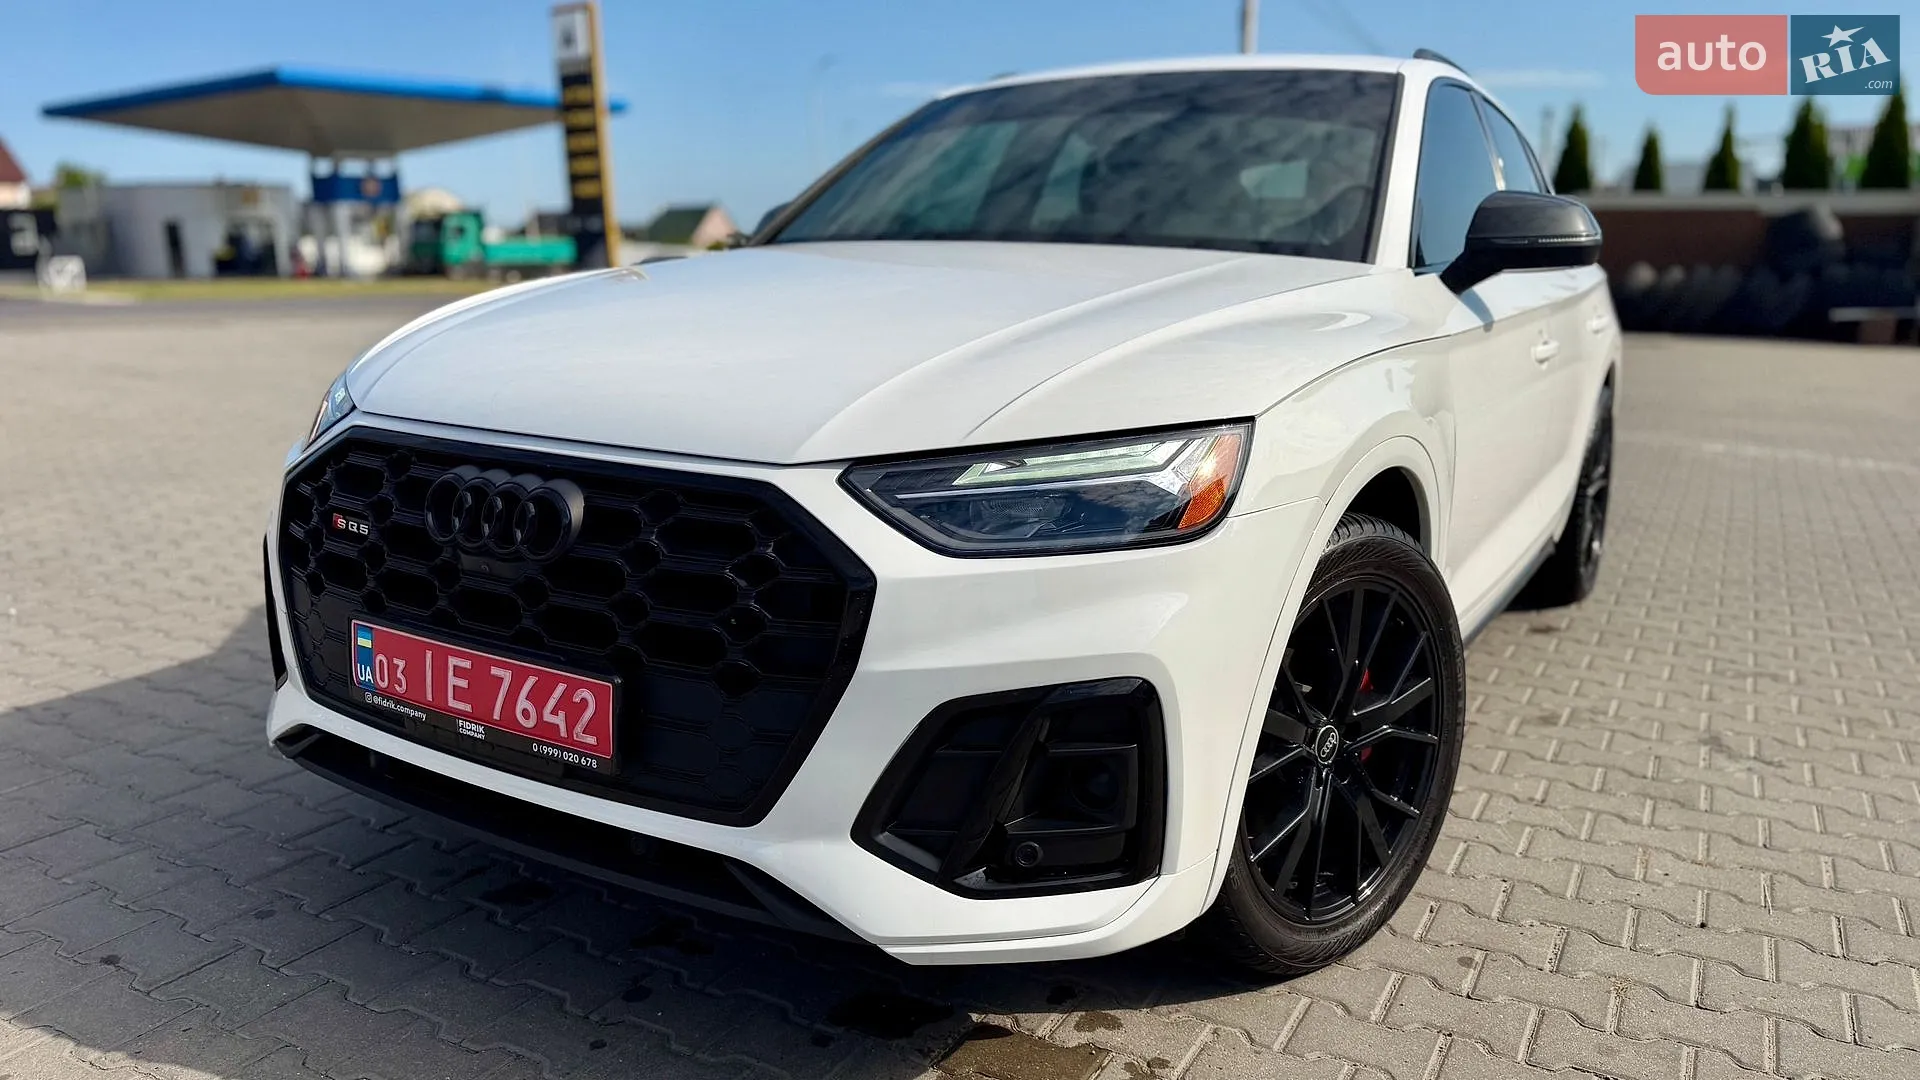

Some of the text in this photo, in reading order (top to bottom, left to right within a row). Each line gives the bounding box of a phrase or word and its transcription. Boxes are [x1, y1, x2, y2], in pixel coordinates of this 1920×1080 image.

[337, 518, 369, 535] SQ5
[357, 663, 374, 684] UA
[373, 695, 427, 721] @fidrik.company
[375, 650, 597, 745] 03 IE 7642
[458, 720, 485, 734] FIDRIK
[459, 727, 486, 740] COMPANY
[532, 743, 597, 769] 0 (999) 020 678
